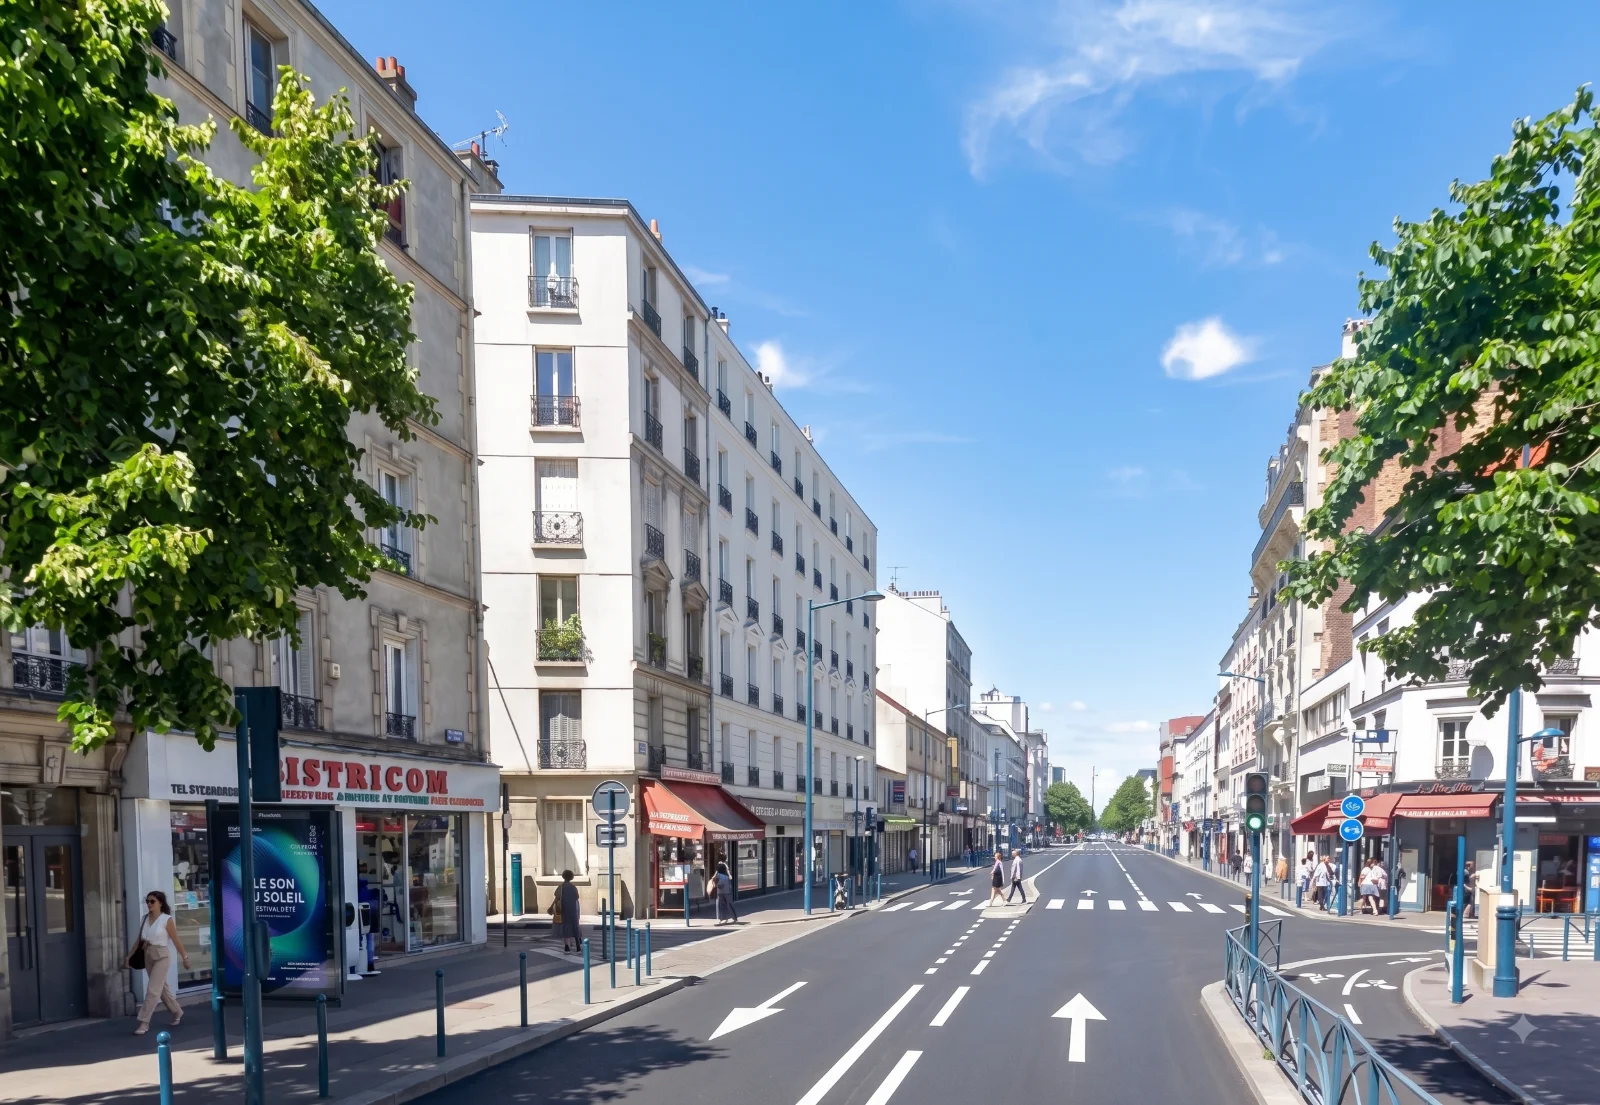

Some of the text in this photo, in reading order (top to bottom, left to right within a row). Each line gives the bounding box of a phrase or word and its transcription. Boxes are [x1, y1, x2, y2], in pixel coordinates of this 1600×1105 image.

[281, 757, 448, 794] ISTRICOM
[171, 784, 188, 794] TEL
[270, 878, 295, 890] SON
[263, 891, 305, 903] SOLEIL
[255, 905, 280, 913] ESTIVAL
